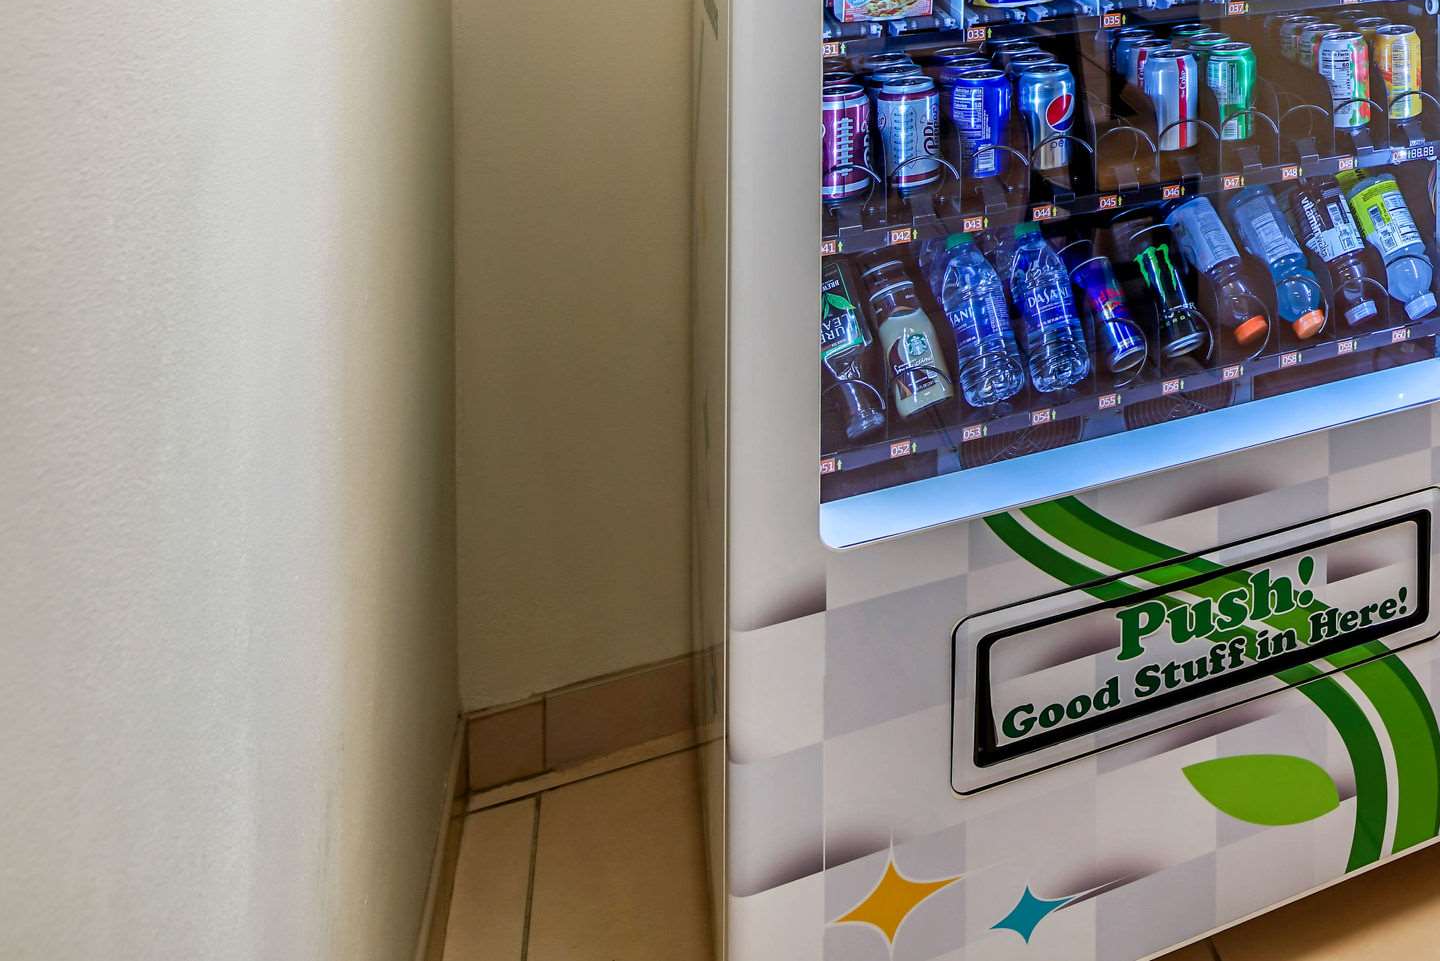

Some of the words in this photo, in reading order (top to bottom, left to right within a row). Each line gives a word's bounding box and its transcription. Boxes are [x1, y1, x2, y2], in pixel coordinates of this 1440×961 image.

[1229, 4, 1245, 13] 037
[1104, 15, 1120, 25] 035
[967, 29, 985, 39] 033
[1282, 168, 1297, 177] 048
[1224, 177, 1240, 186] 047
[1163, 187, 1179, 197] 046
[1100, 198, 1116, 207] 045
[1033, 209, 1050, 218] 044
[964, 219, 982, 229] 043
[891, 230, 910, 240] 042
[1028, 287, 1069, 309] DASANI
[1282, 354, 1297, 363] 058
[1224, 368, 1240, 377] 057
[1163, 382, 1179, 391] 056
[1099, 397, 1116, 406] 055
[1033, 412, 1050, 422] 054
[964, 428, 981, 437] 053
[891, 445, 910, 455] 052
[1115, 555, 1315, 662] Push!
[1001, 681, 1120, 739] Good
[1133, 639, 1247, 698] Stuff
[1256, 623, 1297, 661] in
[1306, 586, 1410, 646] Here!
